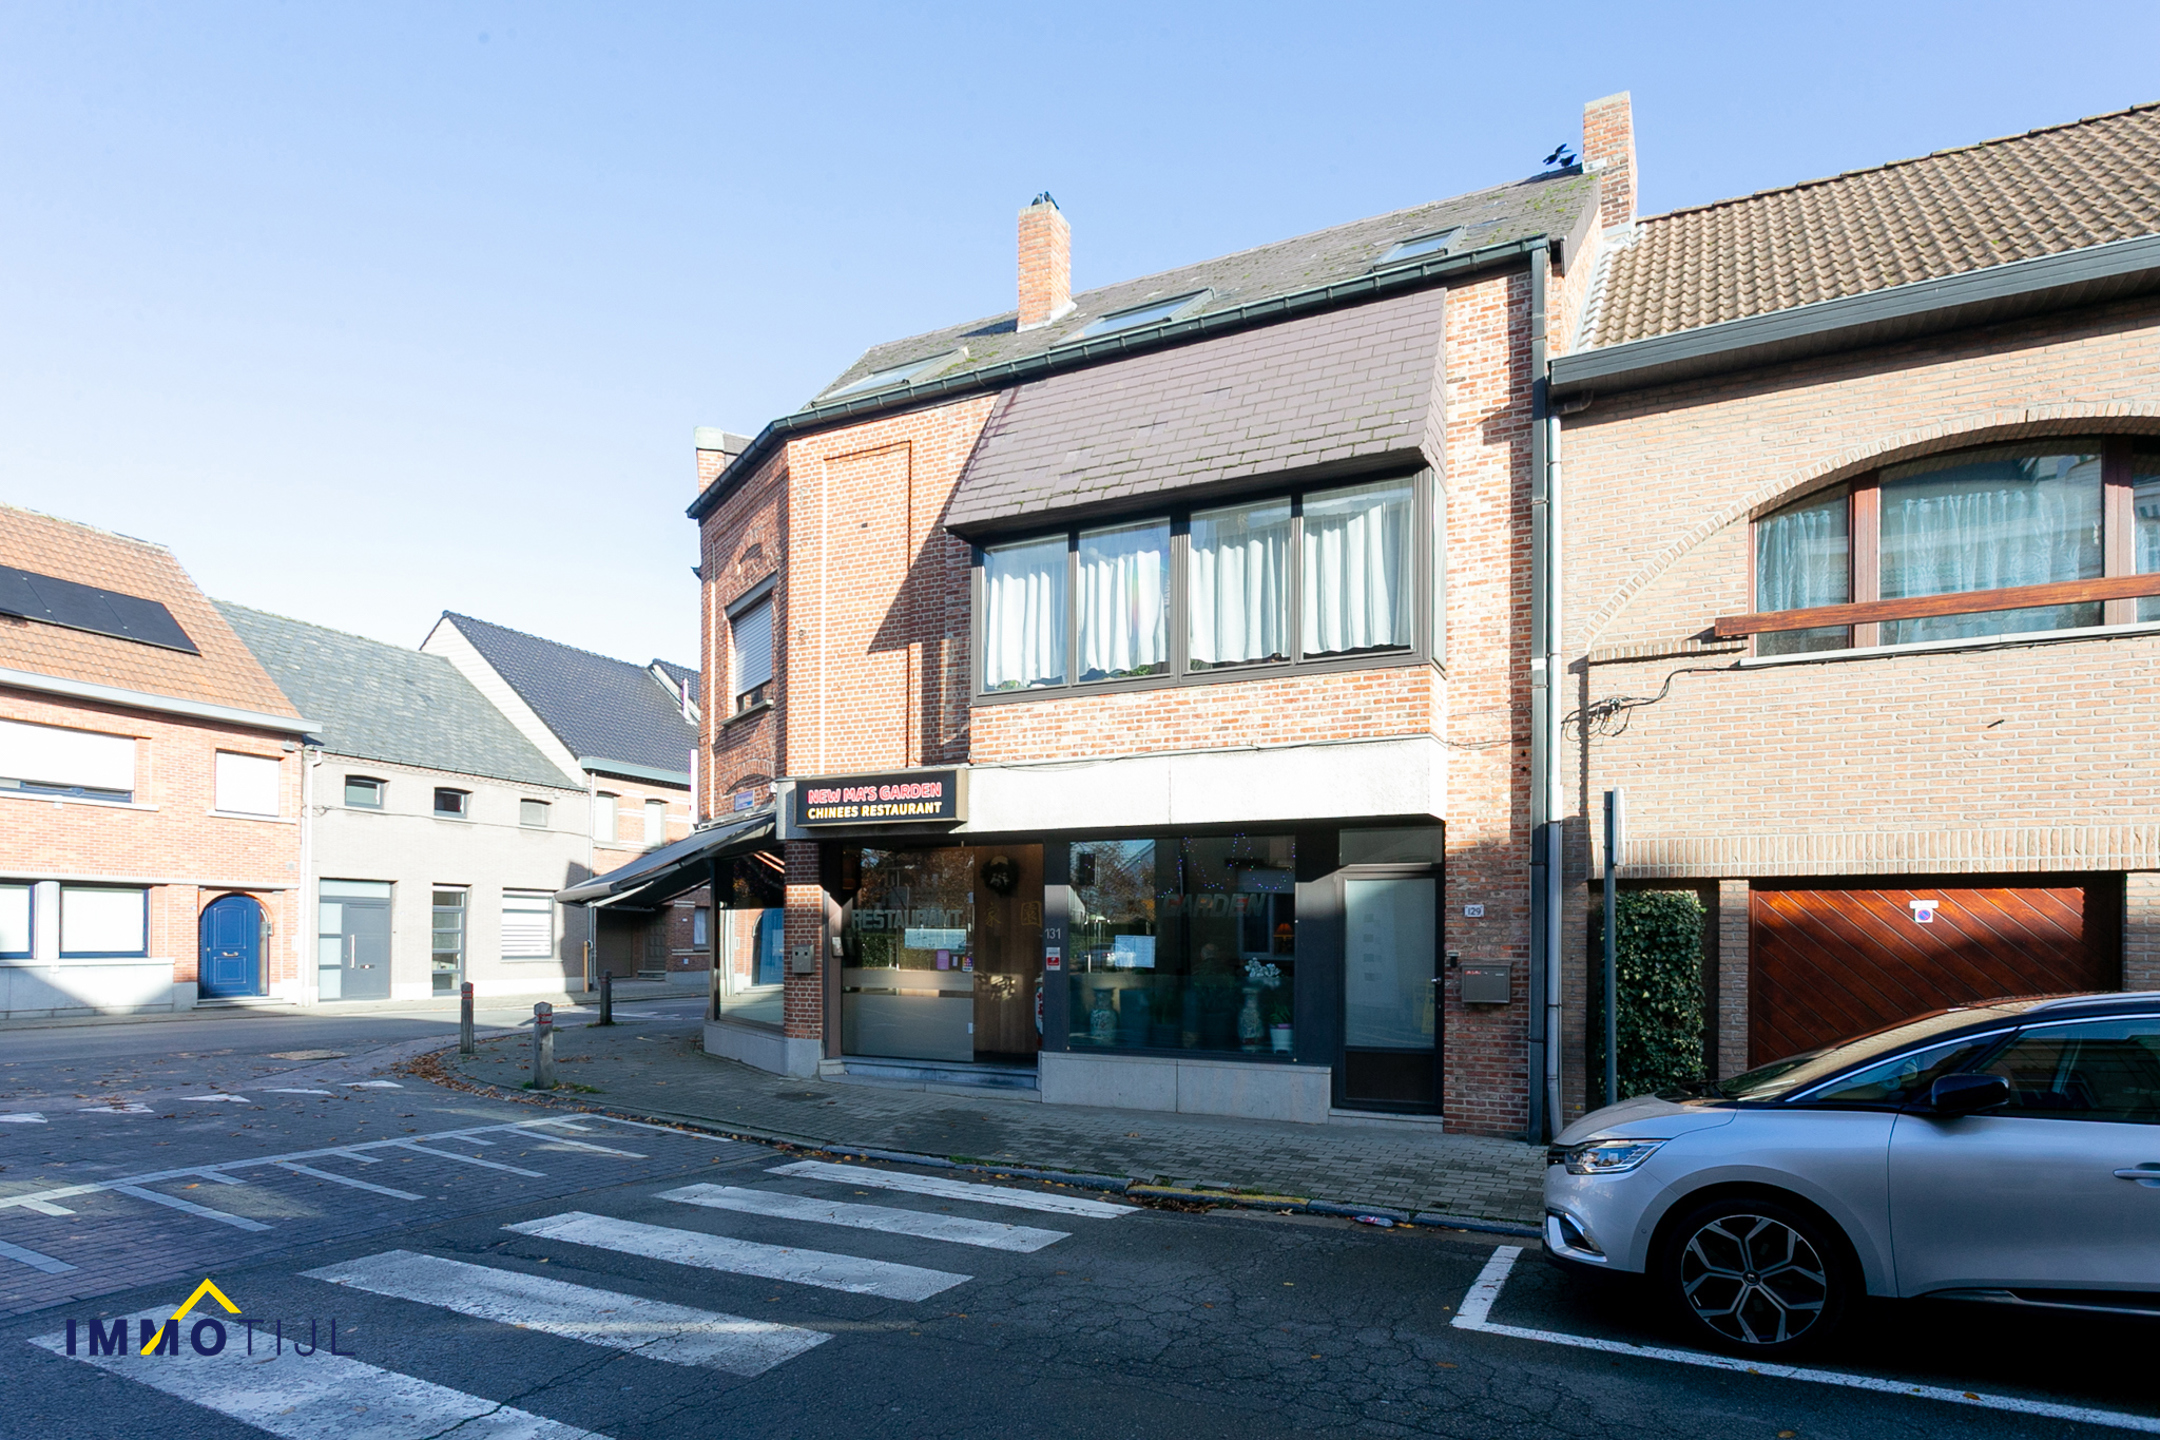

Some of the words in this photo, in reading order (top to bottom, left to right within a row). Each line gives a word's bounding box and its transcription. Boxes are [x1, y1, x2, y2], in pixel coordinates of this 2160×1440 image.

[807, 788, 841, 804] NEW
[843, 786, 878, 803] MA'S
[878, 782, 942, 800] GARDEN
[807, 806, 859, 819] CHINEES
[861, 801, 942, 817] RESTAURANT
[1162, 893, 1266, 918] GARDEN
[1467, 907, 1481, 915] 129
[851, 909, 964, 929] RESTAURANT
[1045, 928, 1061, 939] 131
